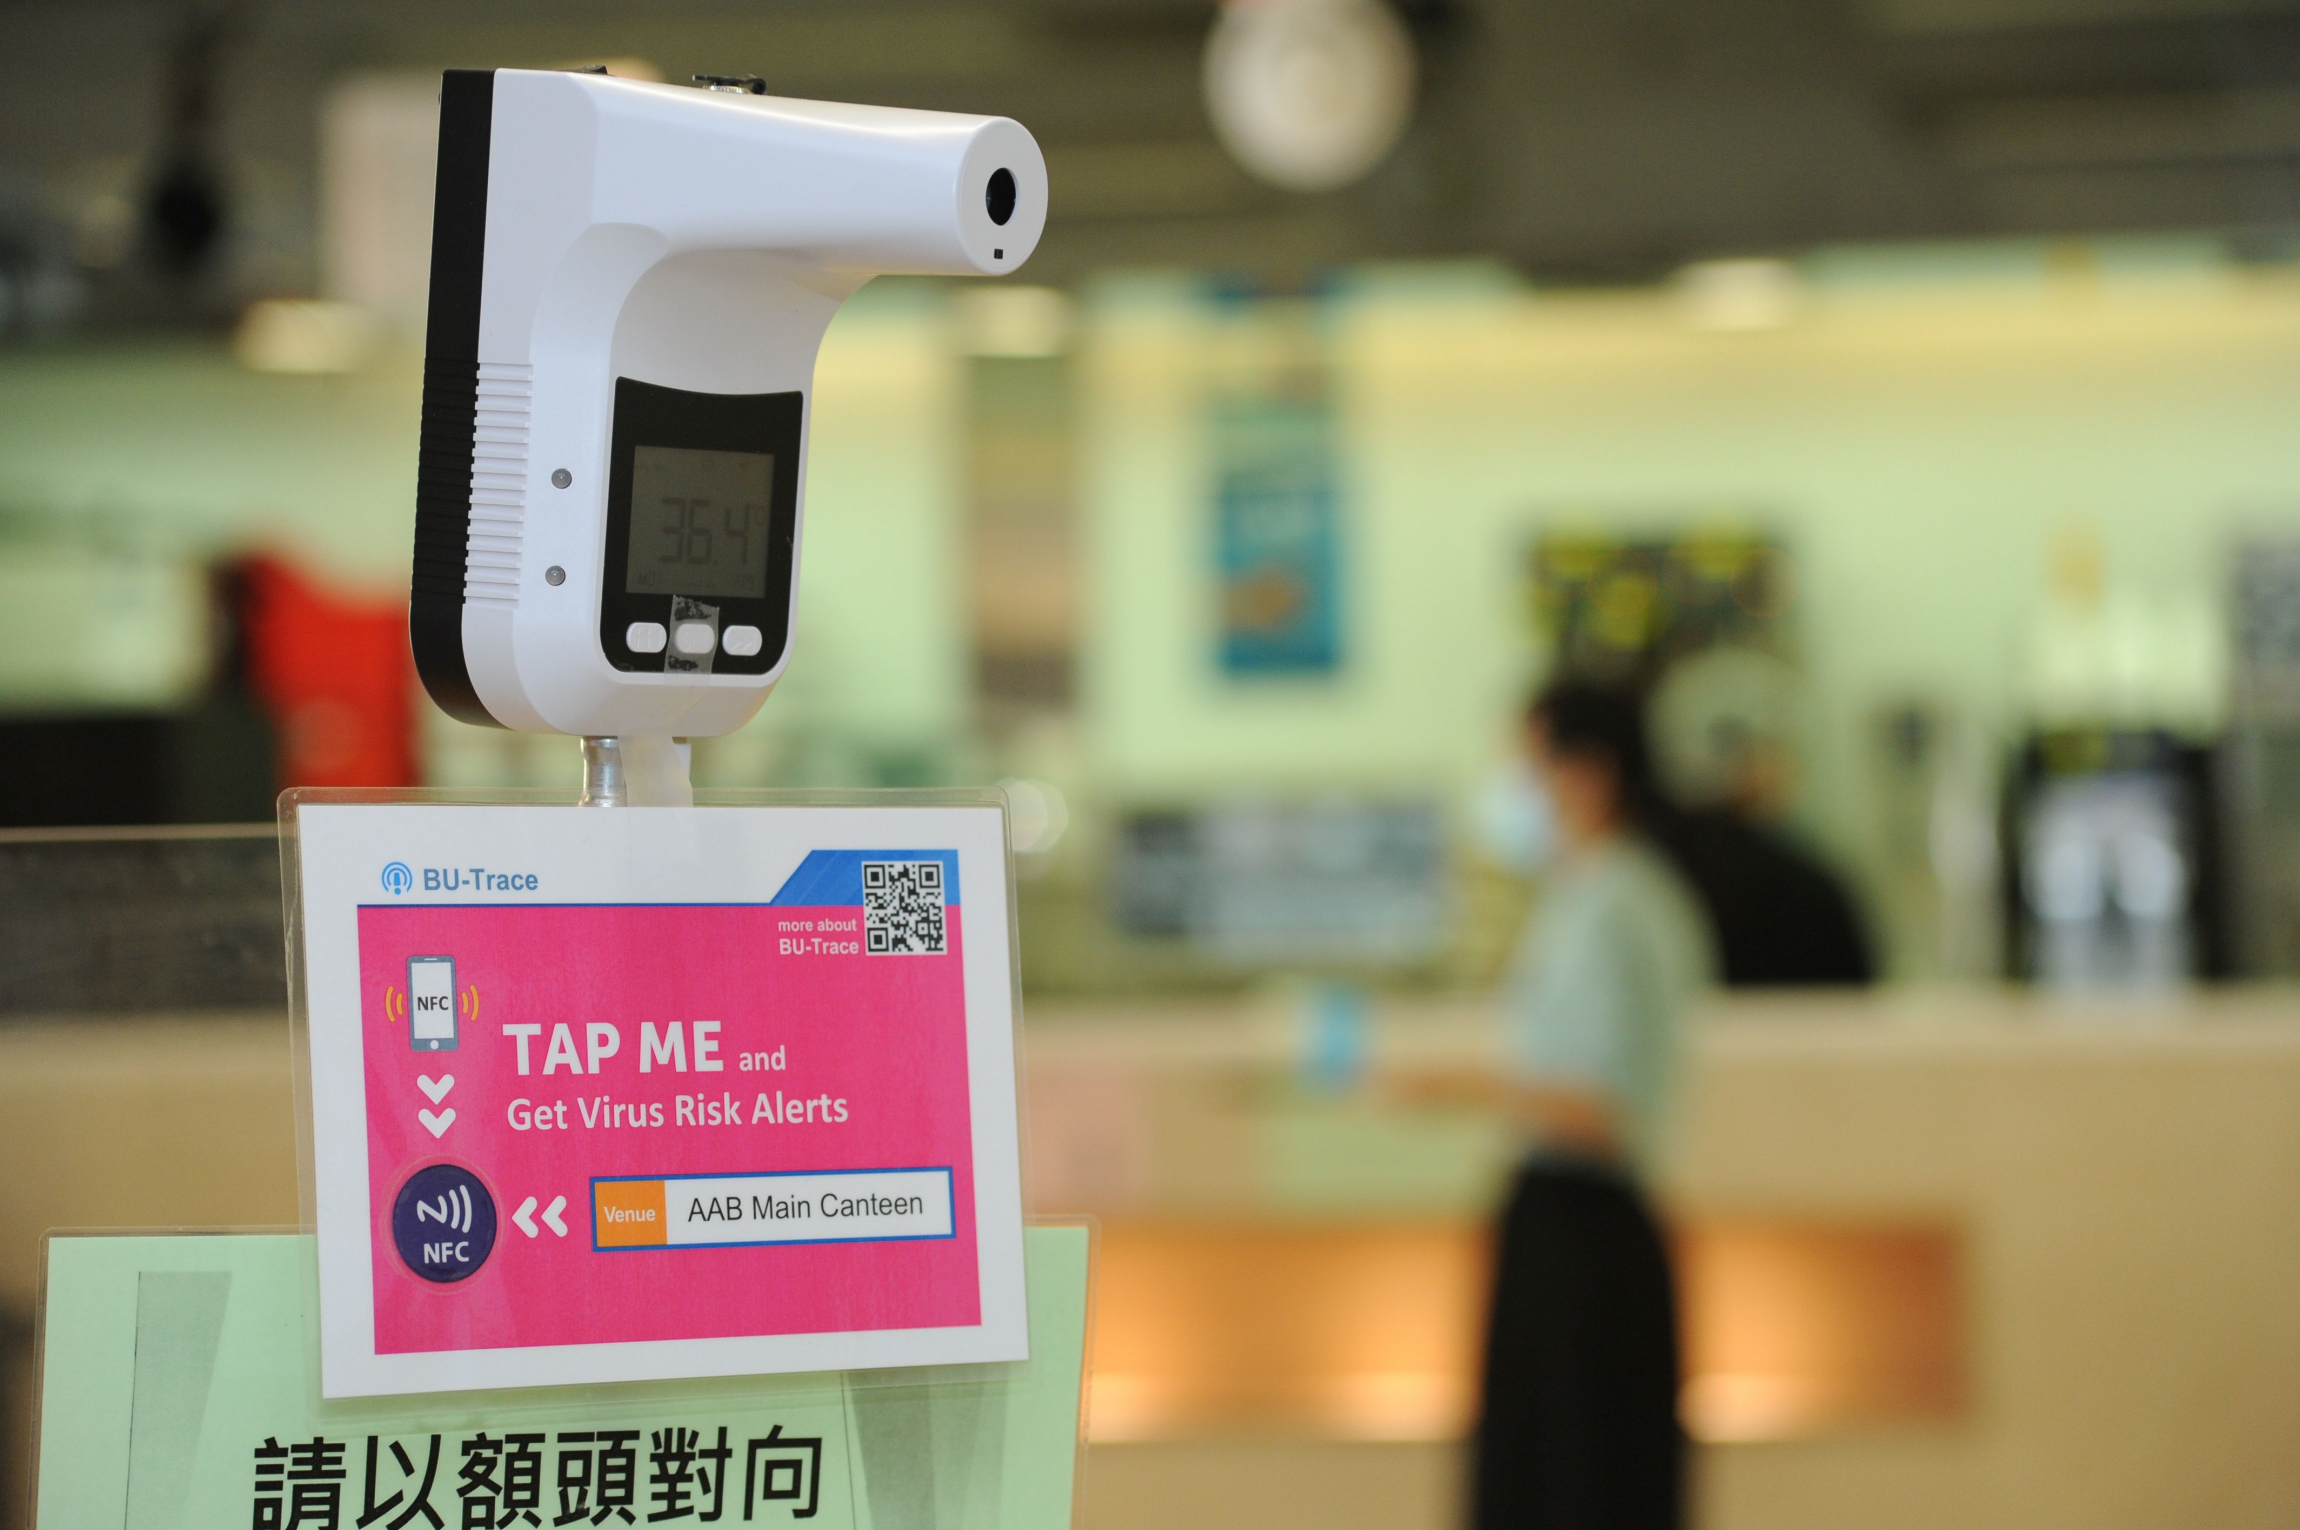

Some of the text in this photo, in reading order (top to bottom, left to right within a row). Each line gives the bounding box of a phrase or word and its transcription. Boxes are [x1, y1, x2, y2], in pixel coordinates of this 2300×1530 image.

[423, 868, 539, 891] BU-Trace
[778, 918, 857, 932] more about
[779, 937, 859, 955] BU-Trace
[417, 995, 449, 1011] NFC
[502, 1020, 786, 1076] TAP ME and
[507, 1090, 849, 1131] Get Virus Risk Alerts
[603, 1206, 656, 1223] Venue
[688, 1193, 923, 1222] AAB Main Canteen
[423, 1241, 470, 1264] NFC
[252, 1424, 822, 1530] 請以額頭對向
